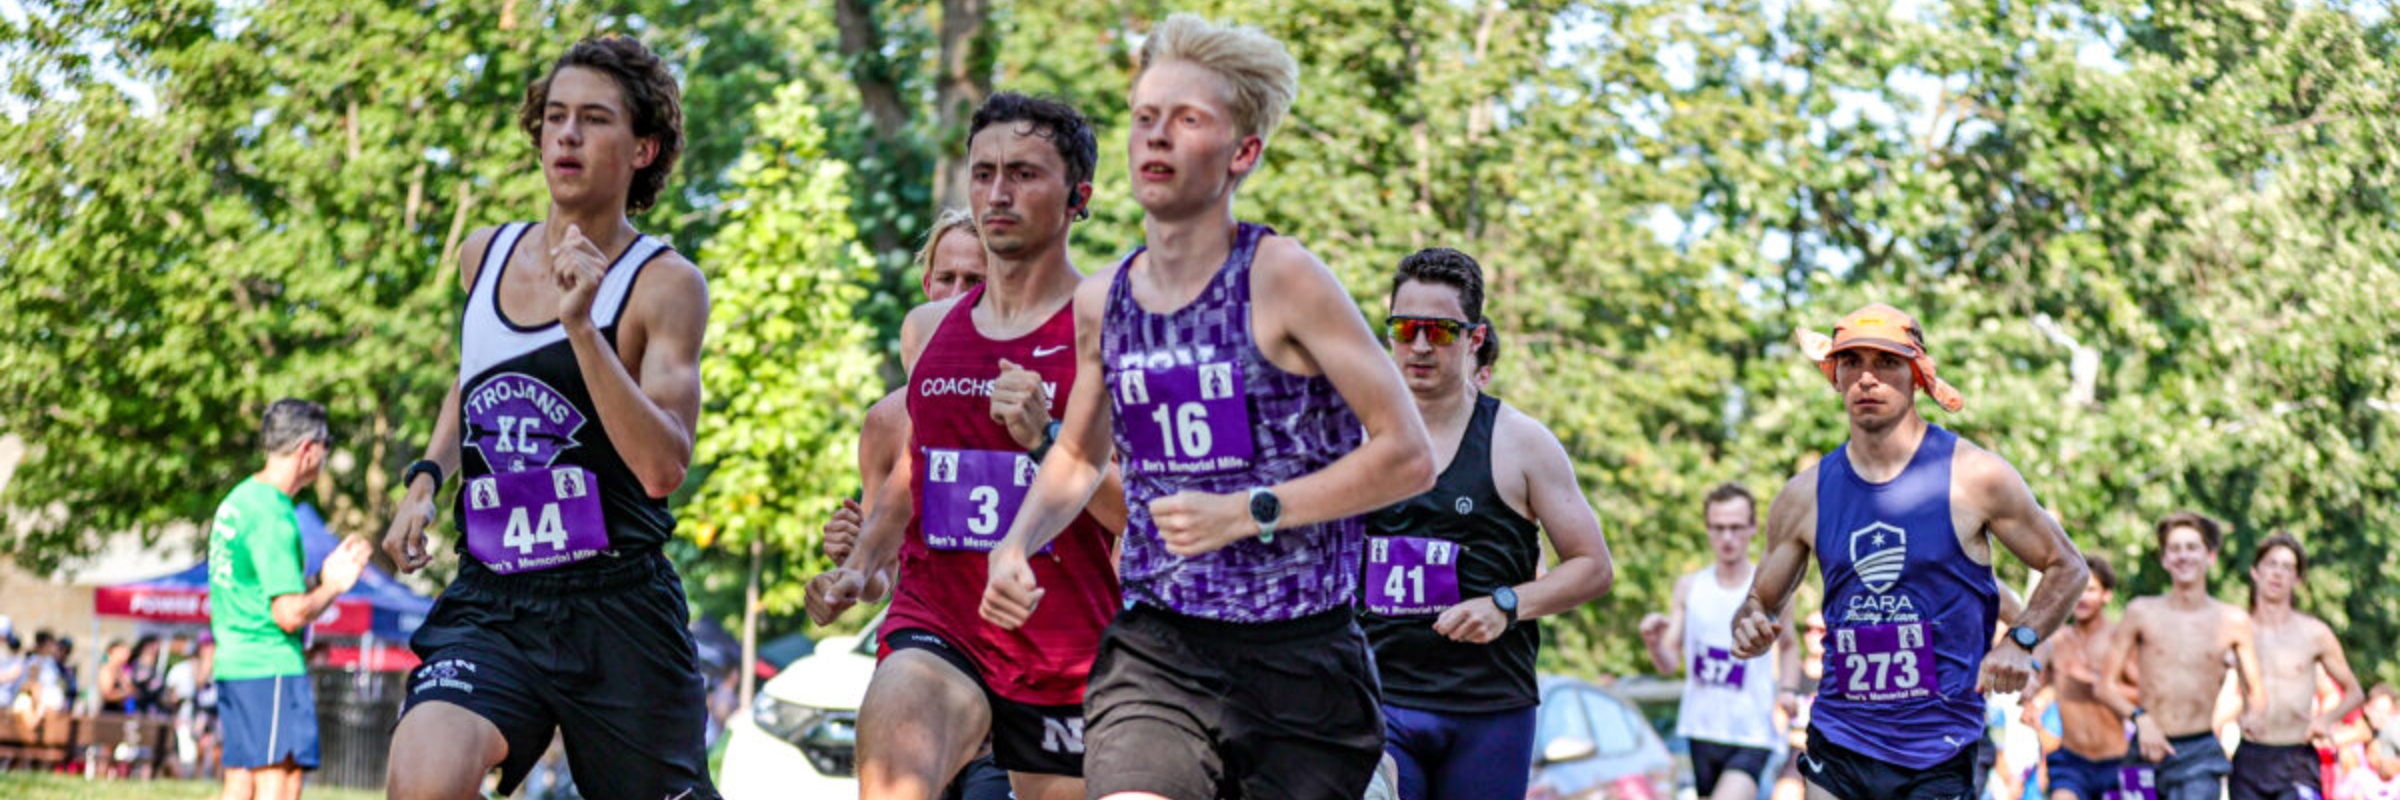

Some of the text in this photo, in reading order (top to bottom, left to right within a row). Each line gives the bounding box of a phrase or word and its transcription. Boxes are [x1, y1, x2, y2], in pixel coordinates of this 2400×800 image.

[471, 380, 569, 424] TROJANS
[495, 416, 540, 455] XC
[1152, 402, 1213, 458] 16
[1142, 456, 1243, 473] Ben's Memorial Mile
[967, 485, 999, 535] 3
[503, 502, 568, 555] 44
[928, 534, 957, 547] Ben's
[518, 552, 570, 568] Memorial
[1384, 566, 1424, 603] 41
[1849, 595, 1914, 610] CARA
[1391, 605, 1433, 615] Memorial
[1701, 659, 1731, 682] 37
[1845, 650, 1920, 691] 273
[1869, 690, 1909, 700] Memorial
[1041, 717, 1085, 753] N
